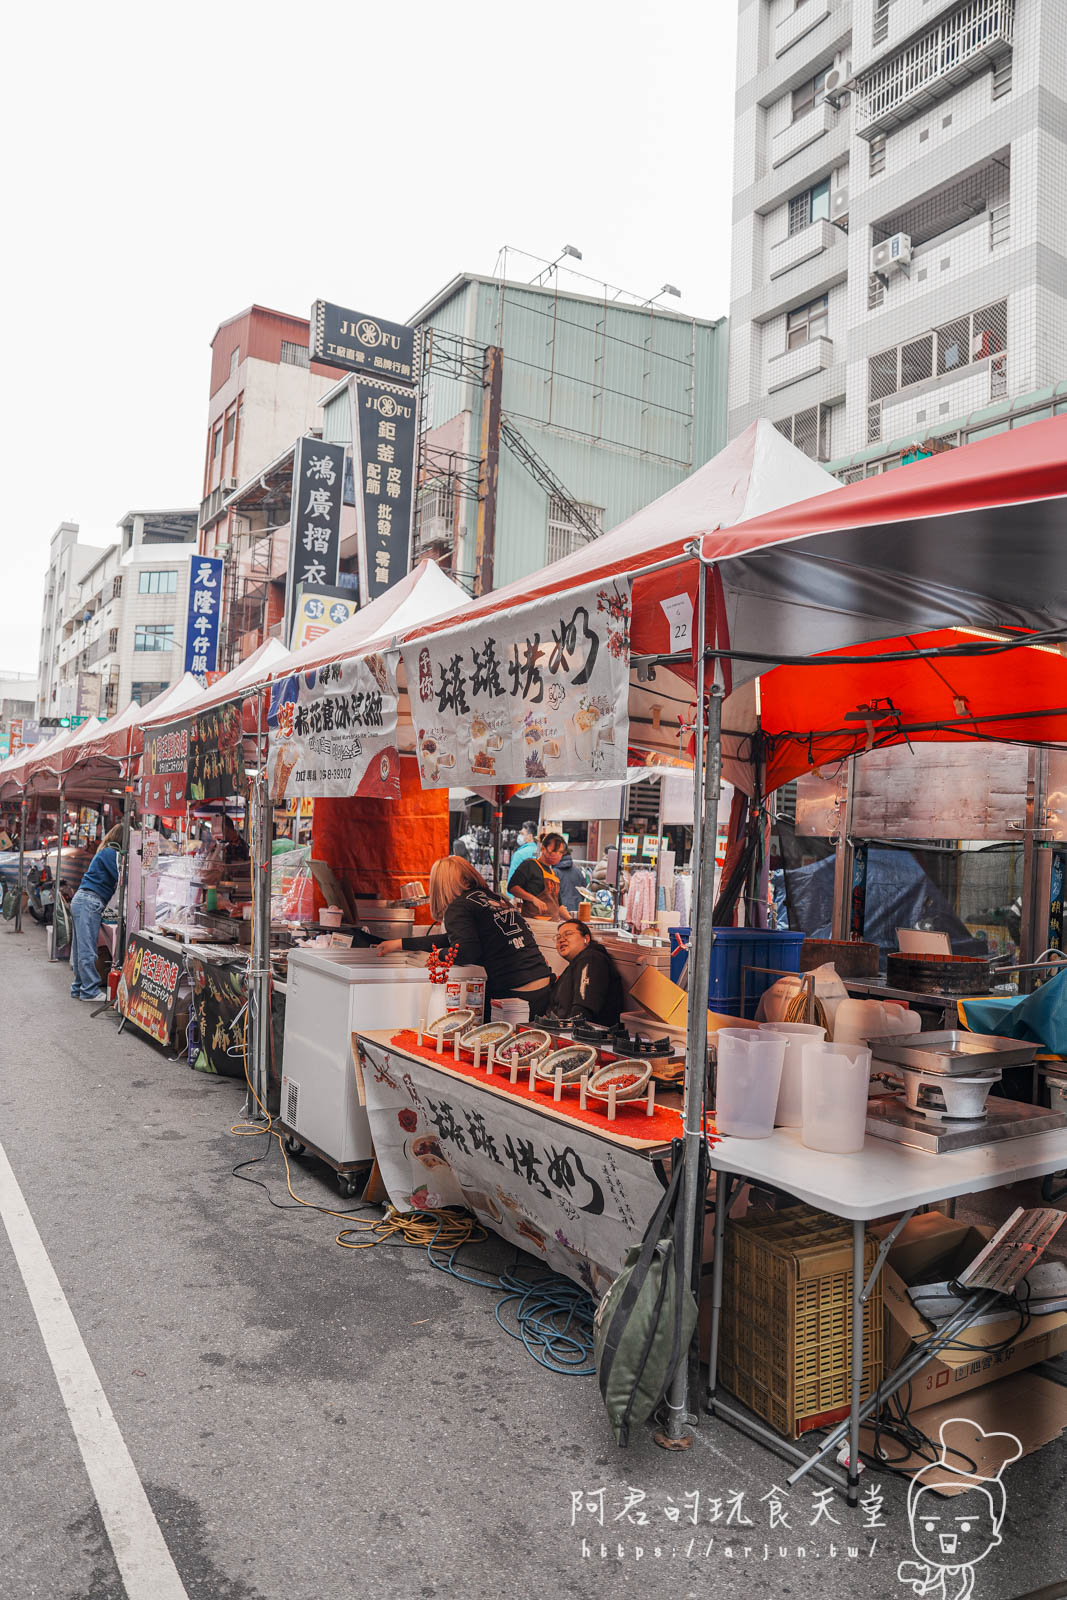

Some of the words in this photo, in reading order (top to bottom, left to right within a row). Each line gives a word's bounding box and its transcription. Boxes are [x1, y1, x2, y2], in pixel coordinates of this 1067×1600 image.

[377, 420, 397, 463] 鉅釜
[365, 462, 382, 496] 配飾
[386, 466, 402, 499] 皮帶
[301, 455, 336, 585] 鴻廣摺衣
[674, 624, 687, 638] 22
[434, 606, 600, 716] 罐罐烤奶
[424, 1096, 604, 1215] 罐罐烤奶
